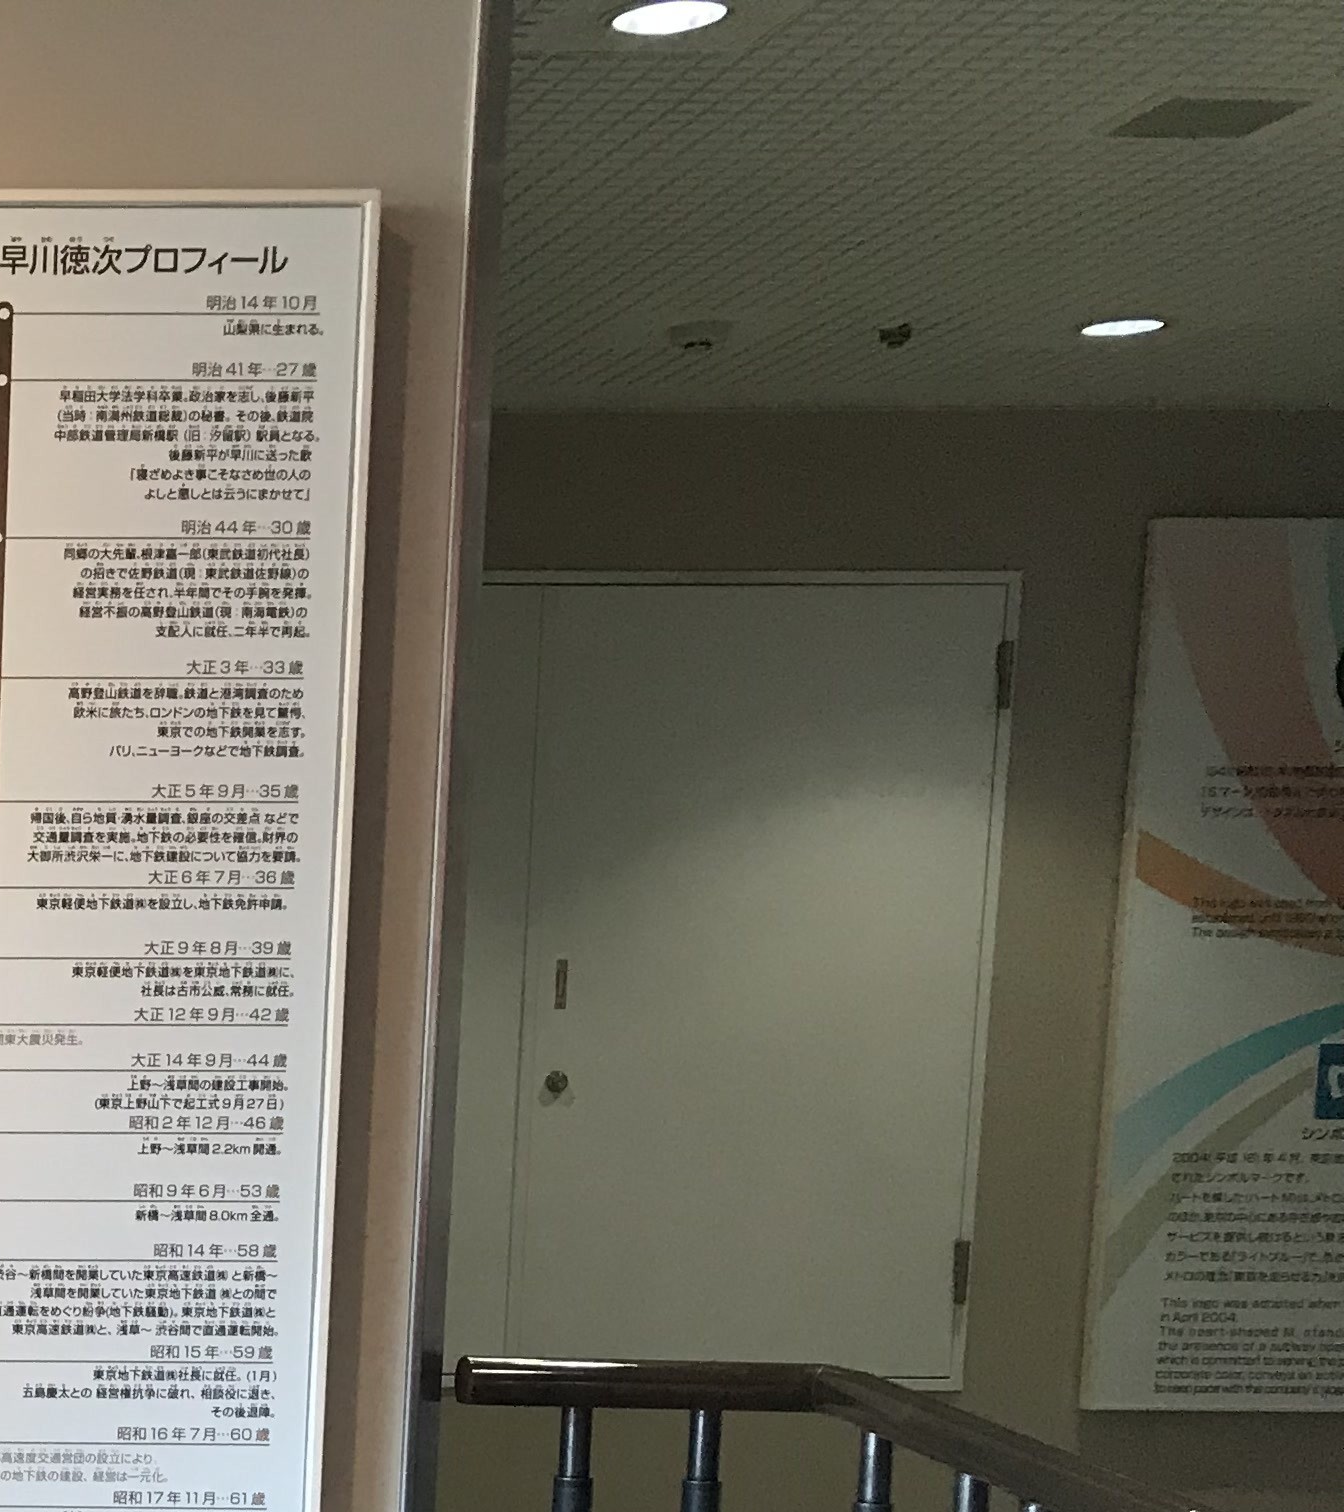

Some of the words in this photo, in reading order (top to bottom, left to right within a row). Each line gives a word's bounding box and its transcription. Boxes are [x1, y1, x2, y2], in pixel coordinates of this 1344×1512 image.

[0, 244, 288, 276] 早川徳次プロフィール
[206, 295, 318, 311] 明治14年10月
